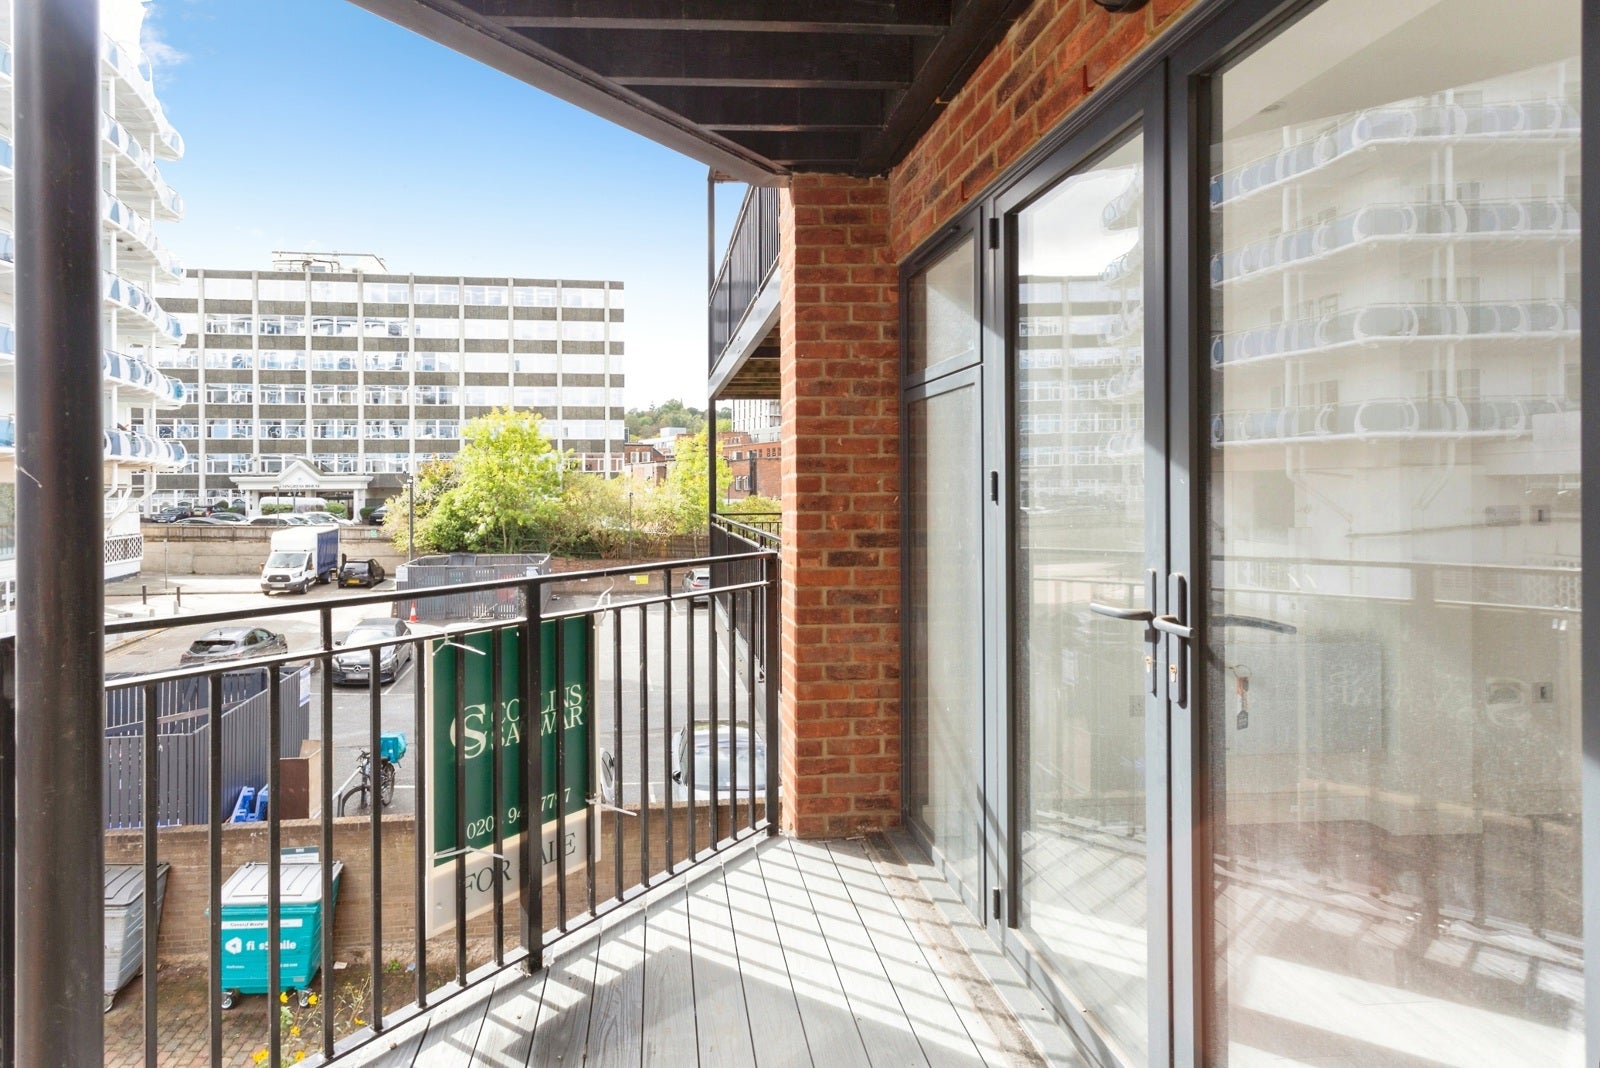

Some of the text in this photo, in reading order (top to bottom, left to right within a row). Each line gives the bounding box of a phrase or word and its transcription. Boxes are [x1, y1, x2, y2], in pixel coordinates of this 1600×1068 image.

[490, 706, 583, 750] AWAR
[541, 788, 571, 813] 777
[464, 859, 512, 899] FOR
